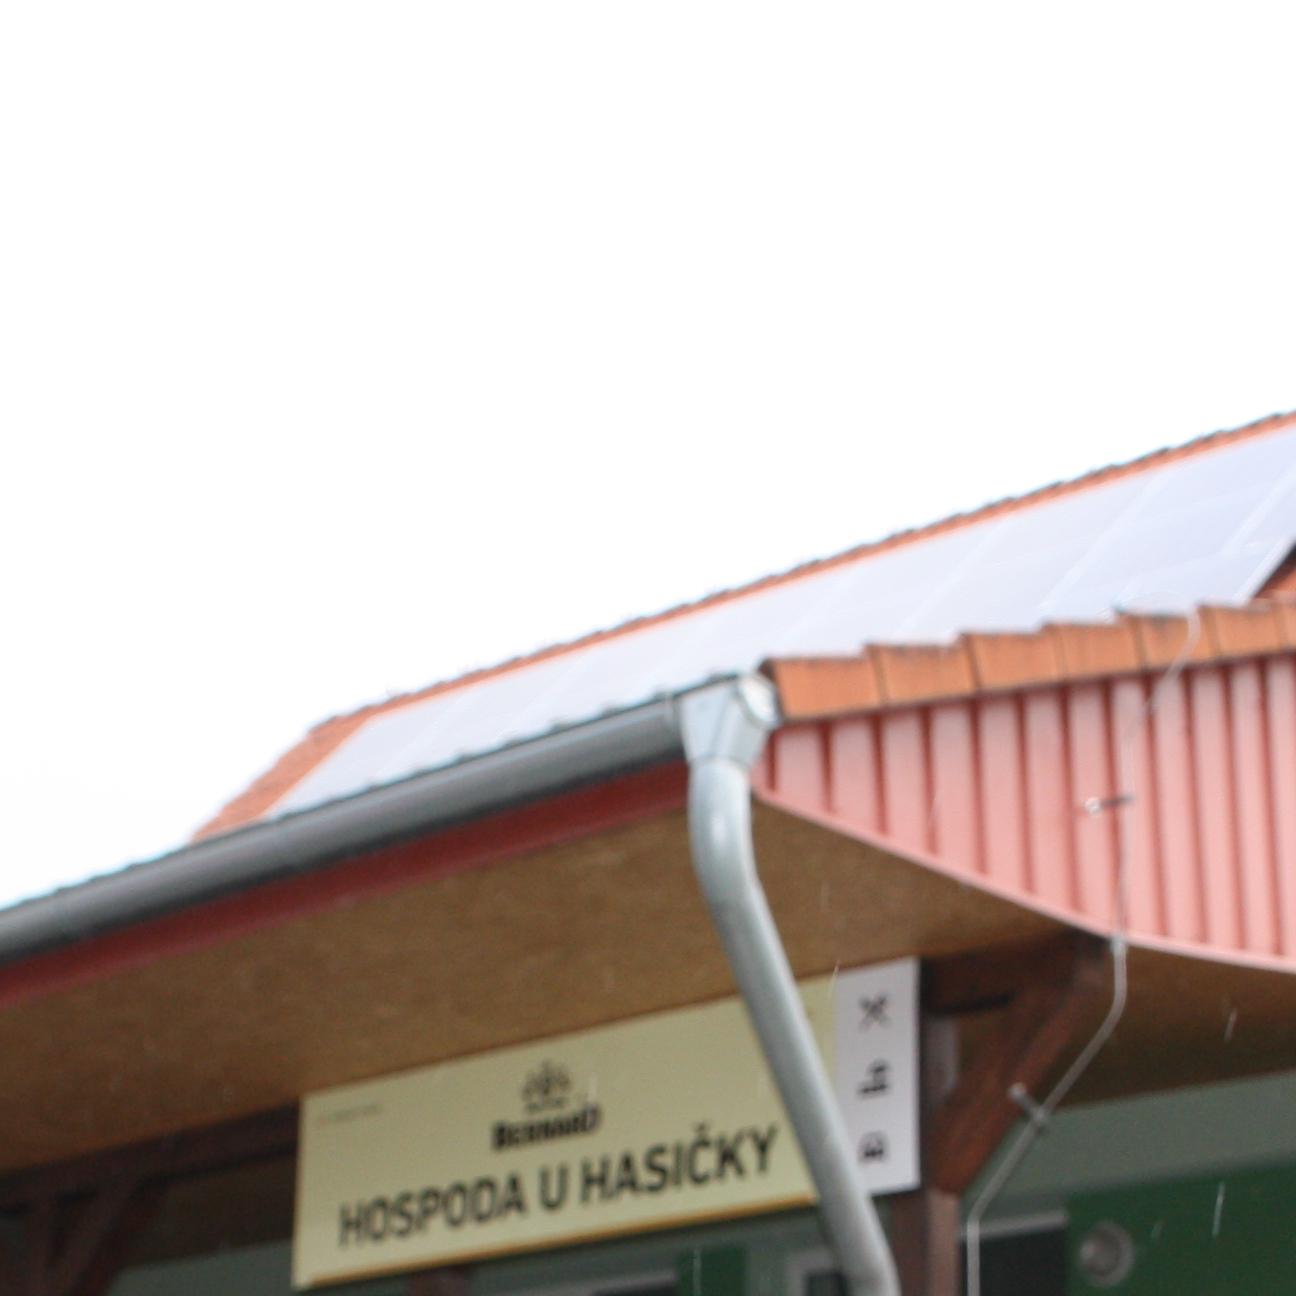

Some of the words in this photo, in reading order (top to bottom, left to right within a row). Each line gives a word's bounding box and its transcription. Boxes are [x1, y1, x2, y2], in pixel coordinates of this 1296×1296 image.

[339, 1176, 526, 1247] HOSPODA
[538, 1164, 568, 1211] U
[580, 1121, 780, 1202] HASIČKY
